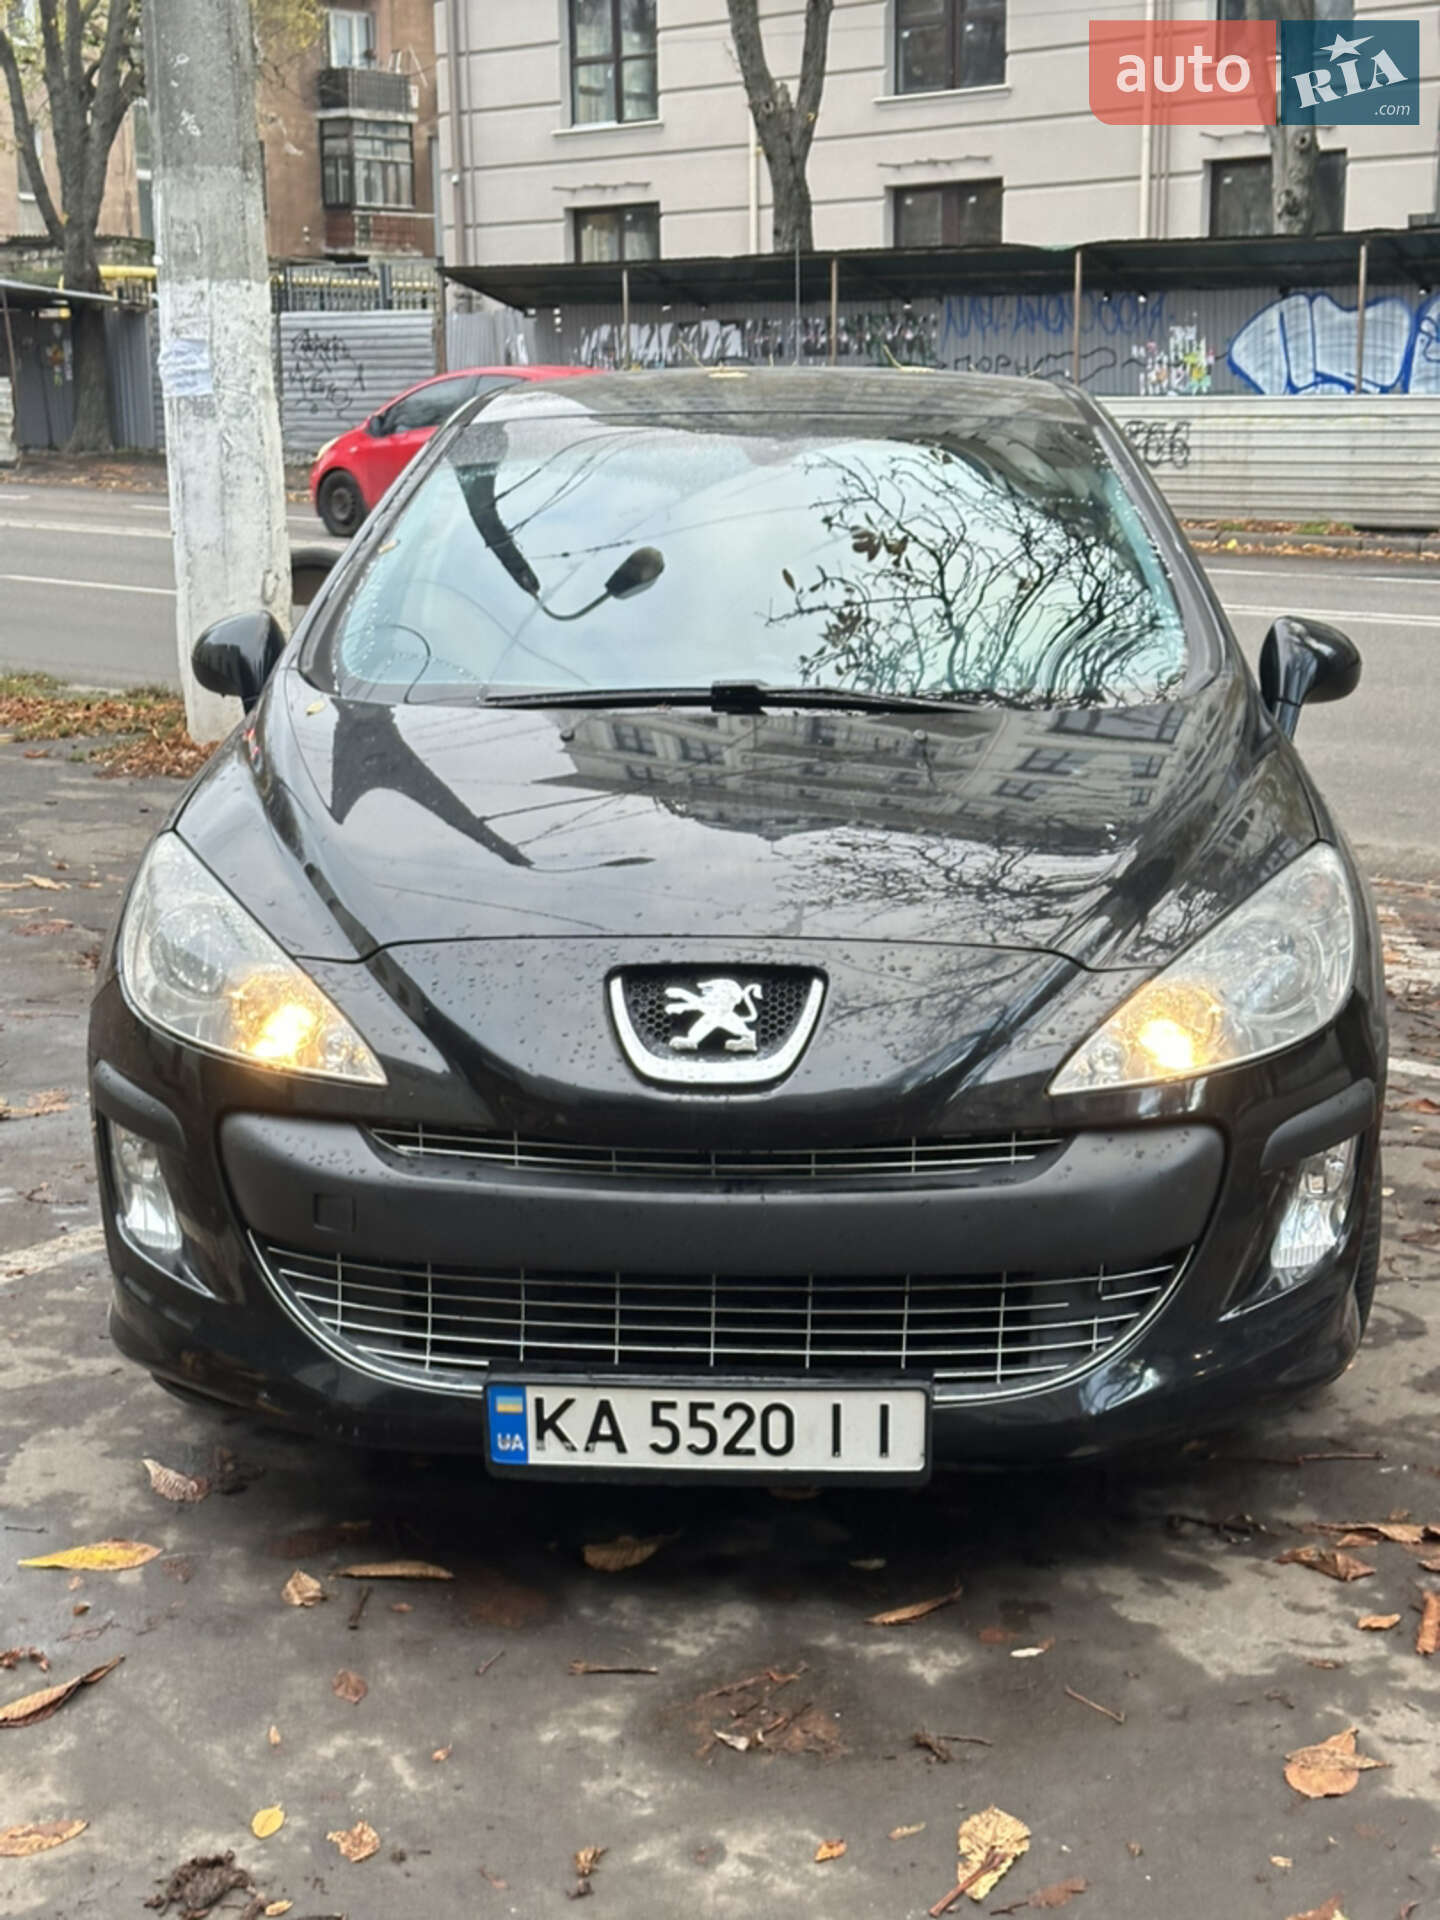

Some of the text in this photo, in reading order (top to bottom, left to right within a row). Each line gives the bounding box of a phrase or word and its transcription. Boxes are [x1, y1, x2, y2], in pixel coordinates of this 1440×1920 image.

[497, 1434, 524, 1451] UA
[534, 1397, 628, 1453] KA
[649, 1401, 794, 1456] 5520
